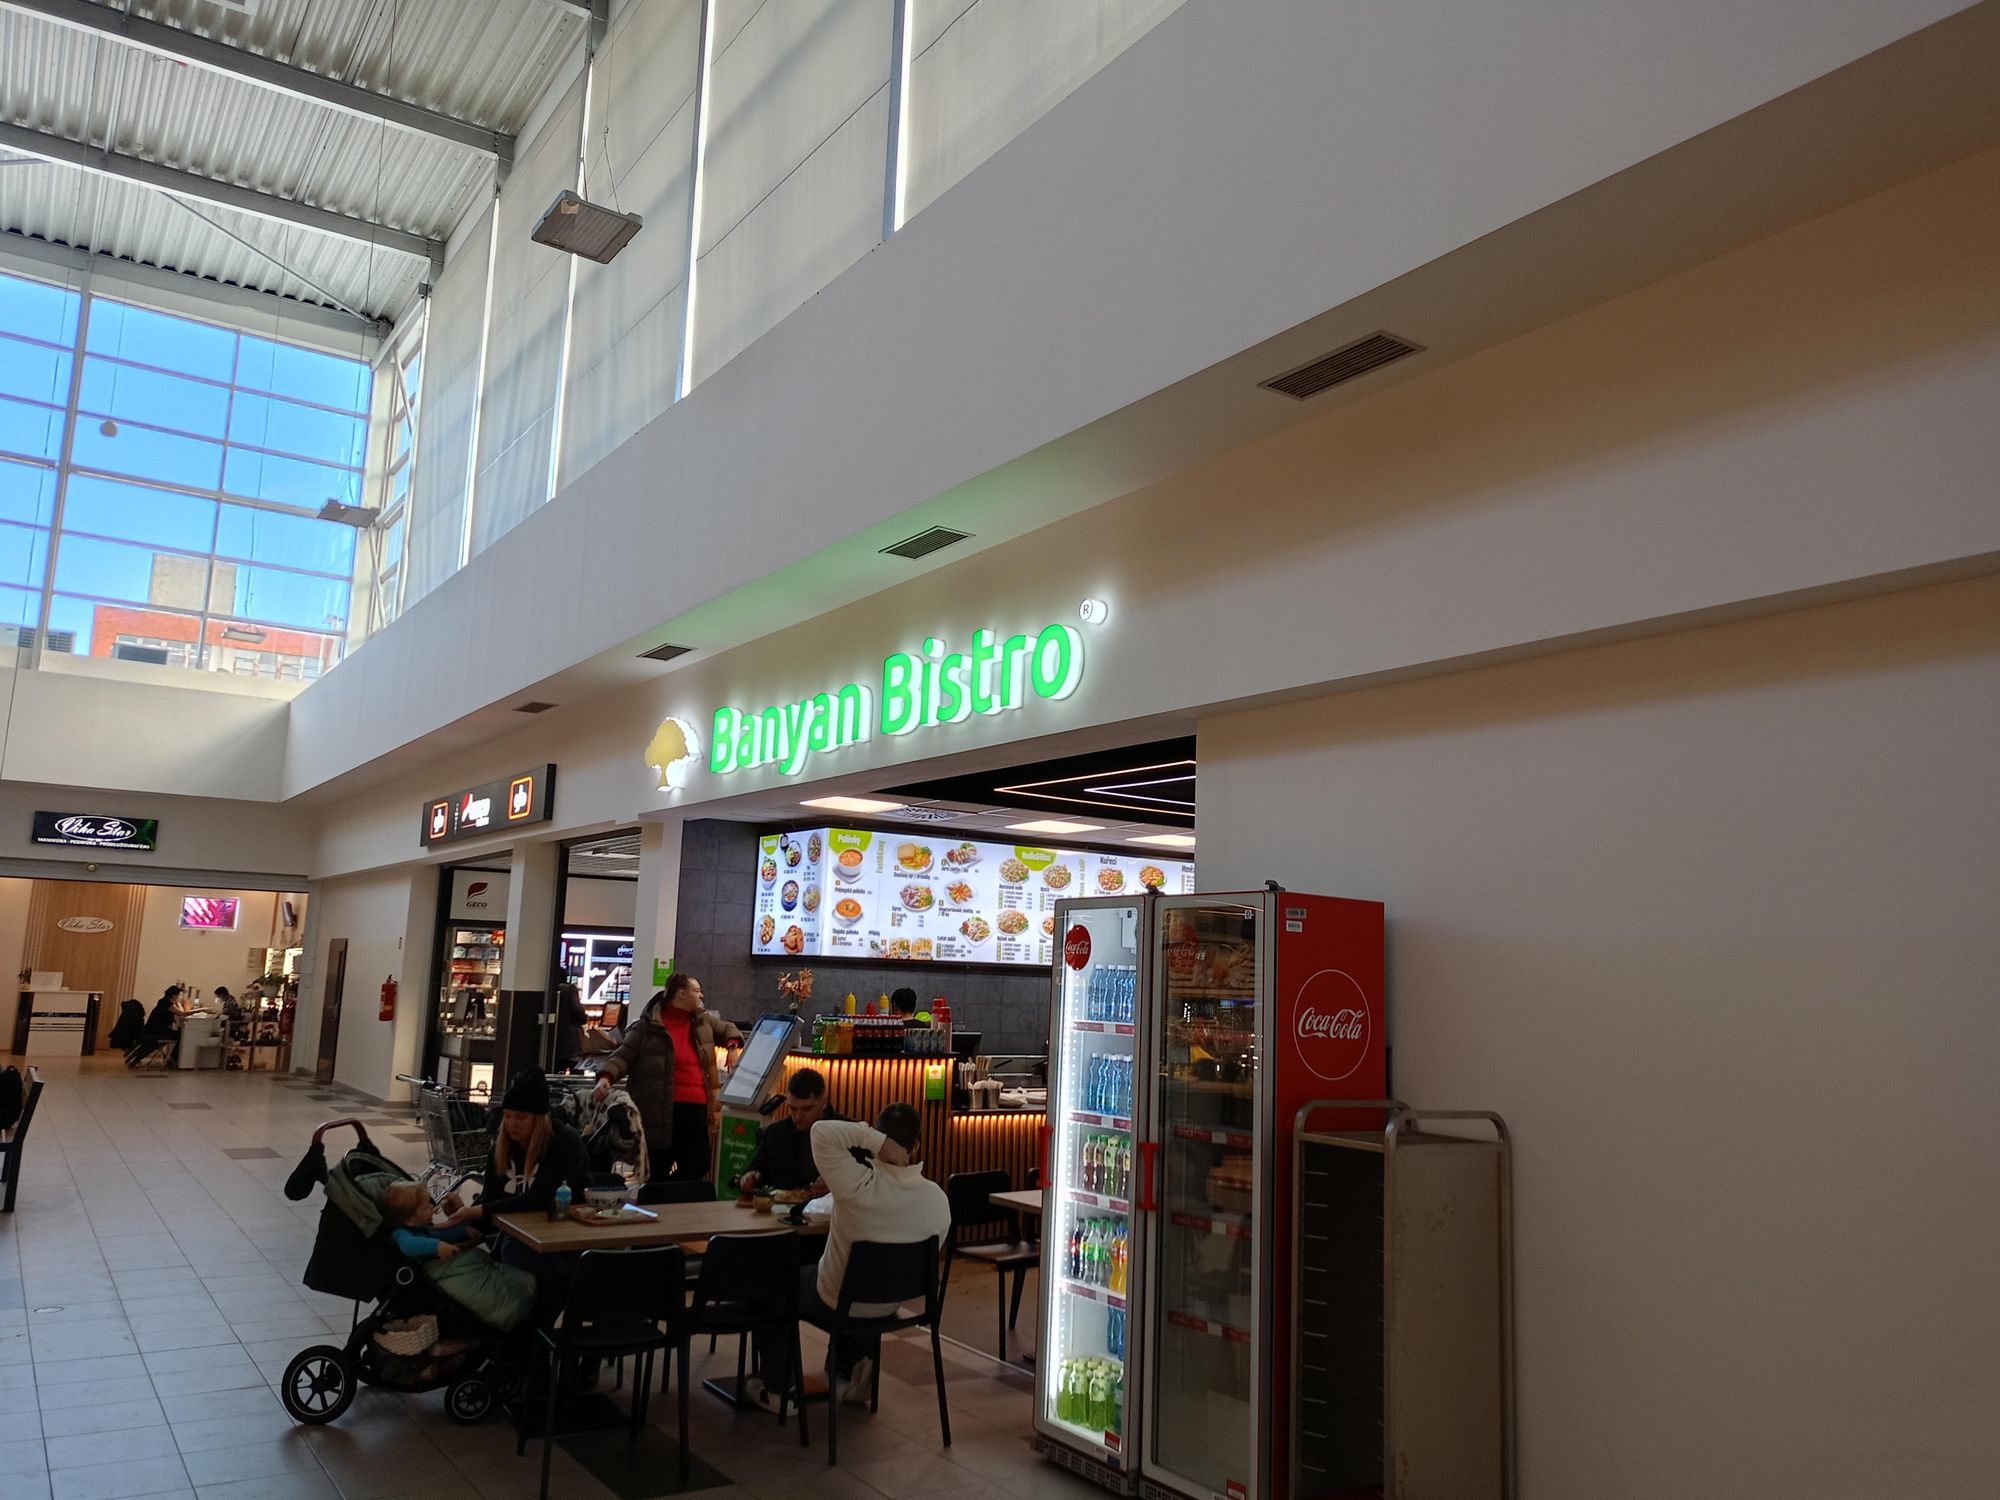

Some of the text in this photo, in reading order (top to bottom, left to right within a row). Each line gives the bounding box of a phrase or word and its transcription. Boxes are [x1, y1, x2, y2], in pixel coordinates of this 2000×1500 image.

[710, 683, 869, 776] Banyan
[880, 624, 1081, 735] Bistro
[96, 821, 132, 837] Star
[1065, 940, 1090, 955] Coca-Cola
[1298, 1007, 1366, 1039] Coca-Cola
